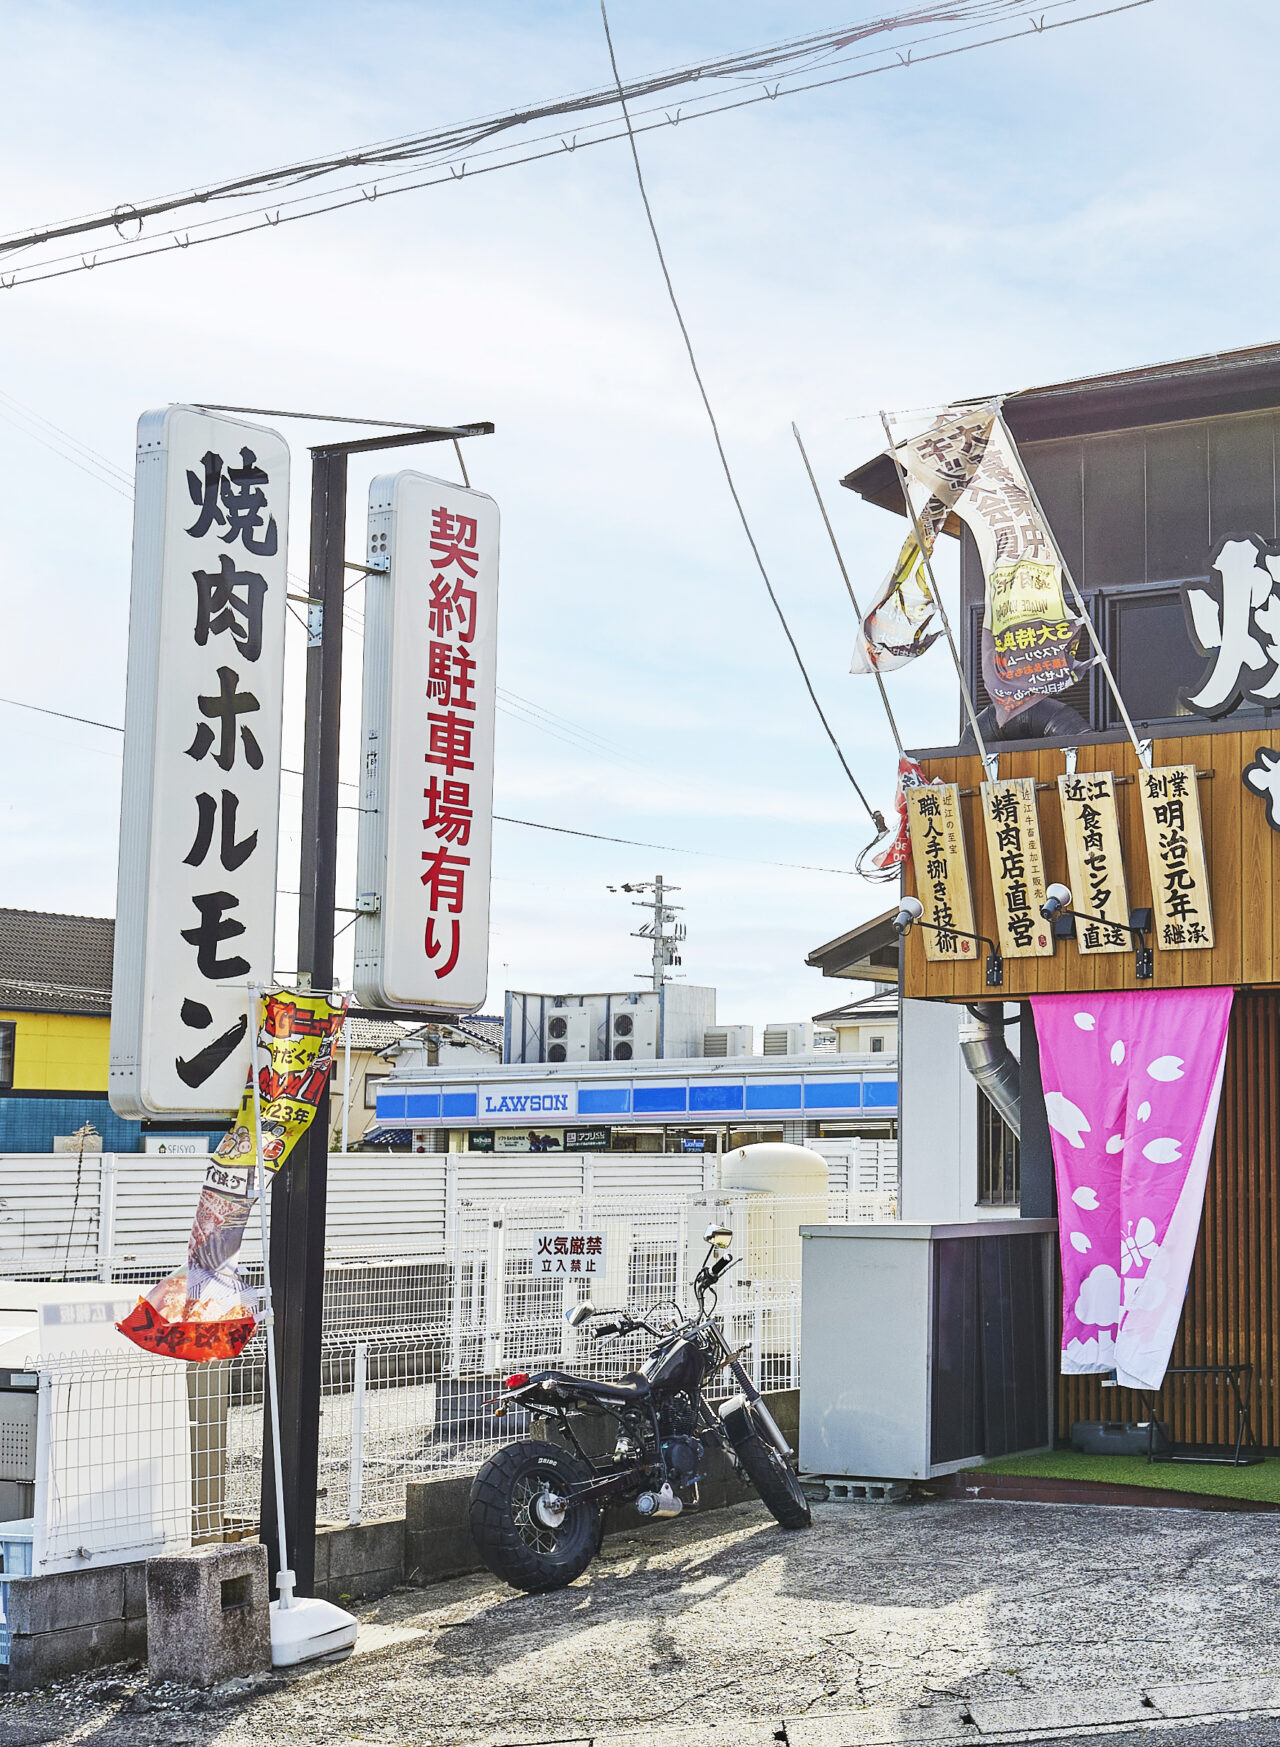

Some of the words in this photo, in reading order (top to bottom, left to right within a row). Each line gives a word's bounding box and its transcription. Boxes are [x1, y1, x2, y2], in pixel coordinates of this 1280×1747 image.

[420, 507, 478, 979] 契約駐車場有り
[176, 446, 278, 1089] 焼肉ホルモン
[1146, 771, 1189, 798] 創業
[1065, 779, 1111, 801] 近江
[942, 795, 957, 854] 近江の至宝
[918, 795, 958, 954] 職人手捌き技術
[991, 788, 1035, 948] 精肉店直営
[1075, 803, 1113, 923] 食肉センター
[1153, 800, 1198, 922] 明治元年
[1083, 923, 1127, 949] 直送
[1163, 922, 1209, 945] 継承
[485, 1095, 568, 1112] LAWSON
[537, 1236, 602, 1256] 火気厳禁
[541, 1259, 596, 1274] 立入禁止
